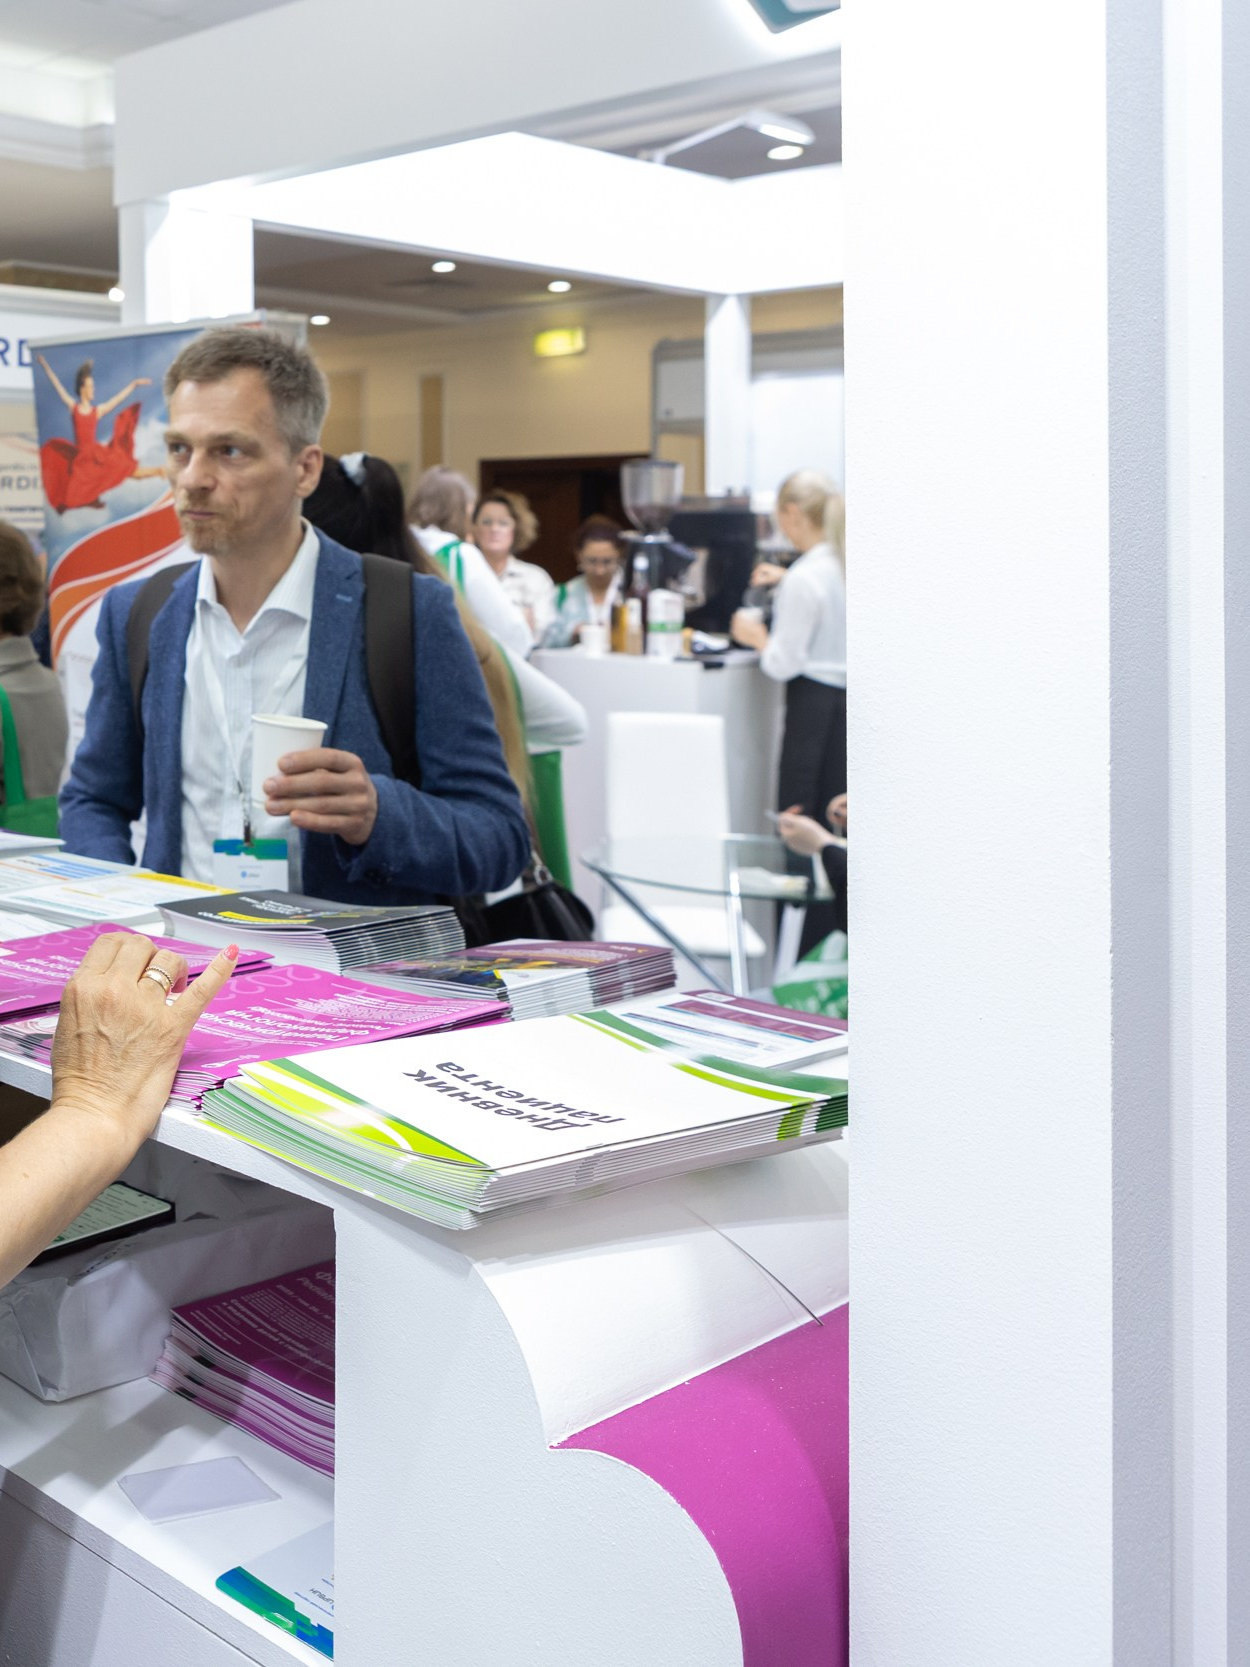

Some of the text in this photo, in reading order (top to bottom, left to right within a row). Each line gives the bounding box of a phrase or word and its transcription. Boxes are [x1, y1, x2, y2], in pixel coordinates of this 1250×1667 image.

[200, 1012, 349, 1041] Педиатрическа
[402, 1069, 593, 1131] Дневник
[435, 1061, 626, 1124] пациента
